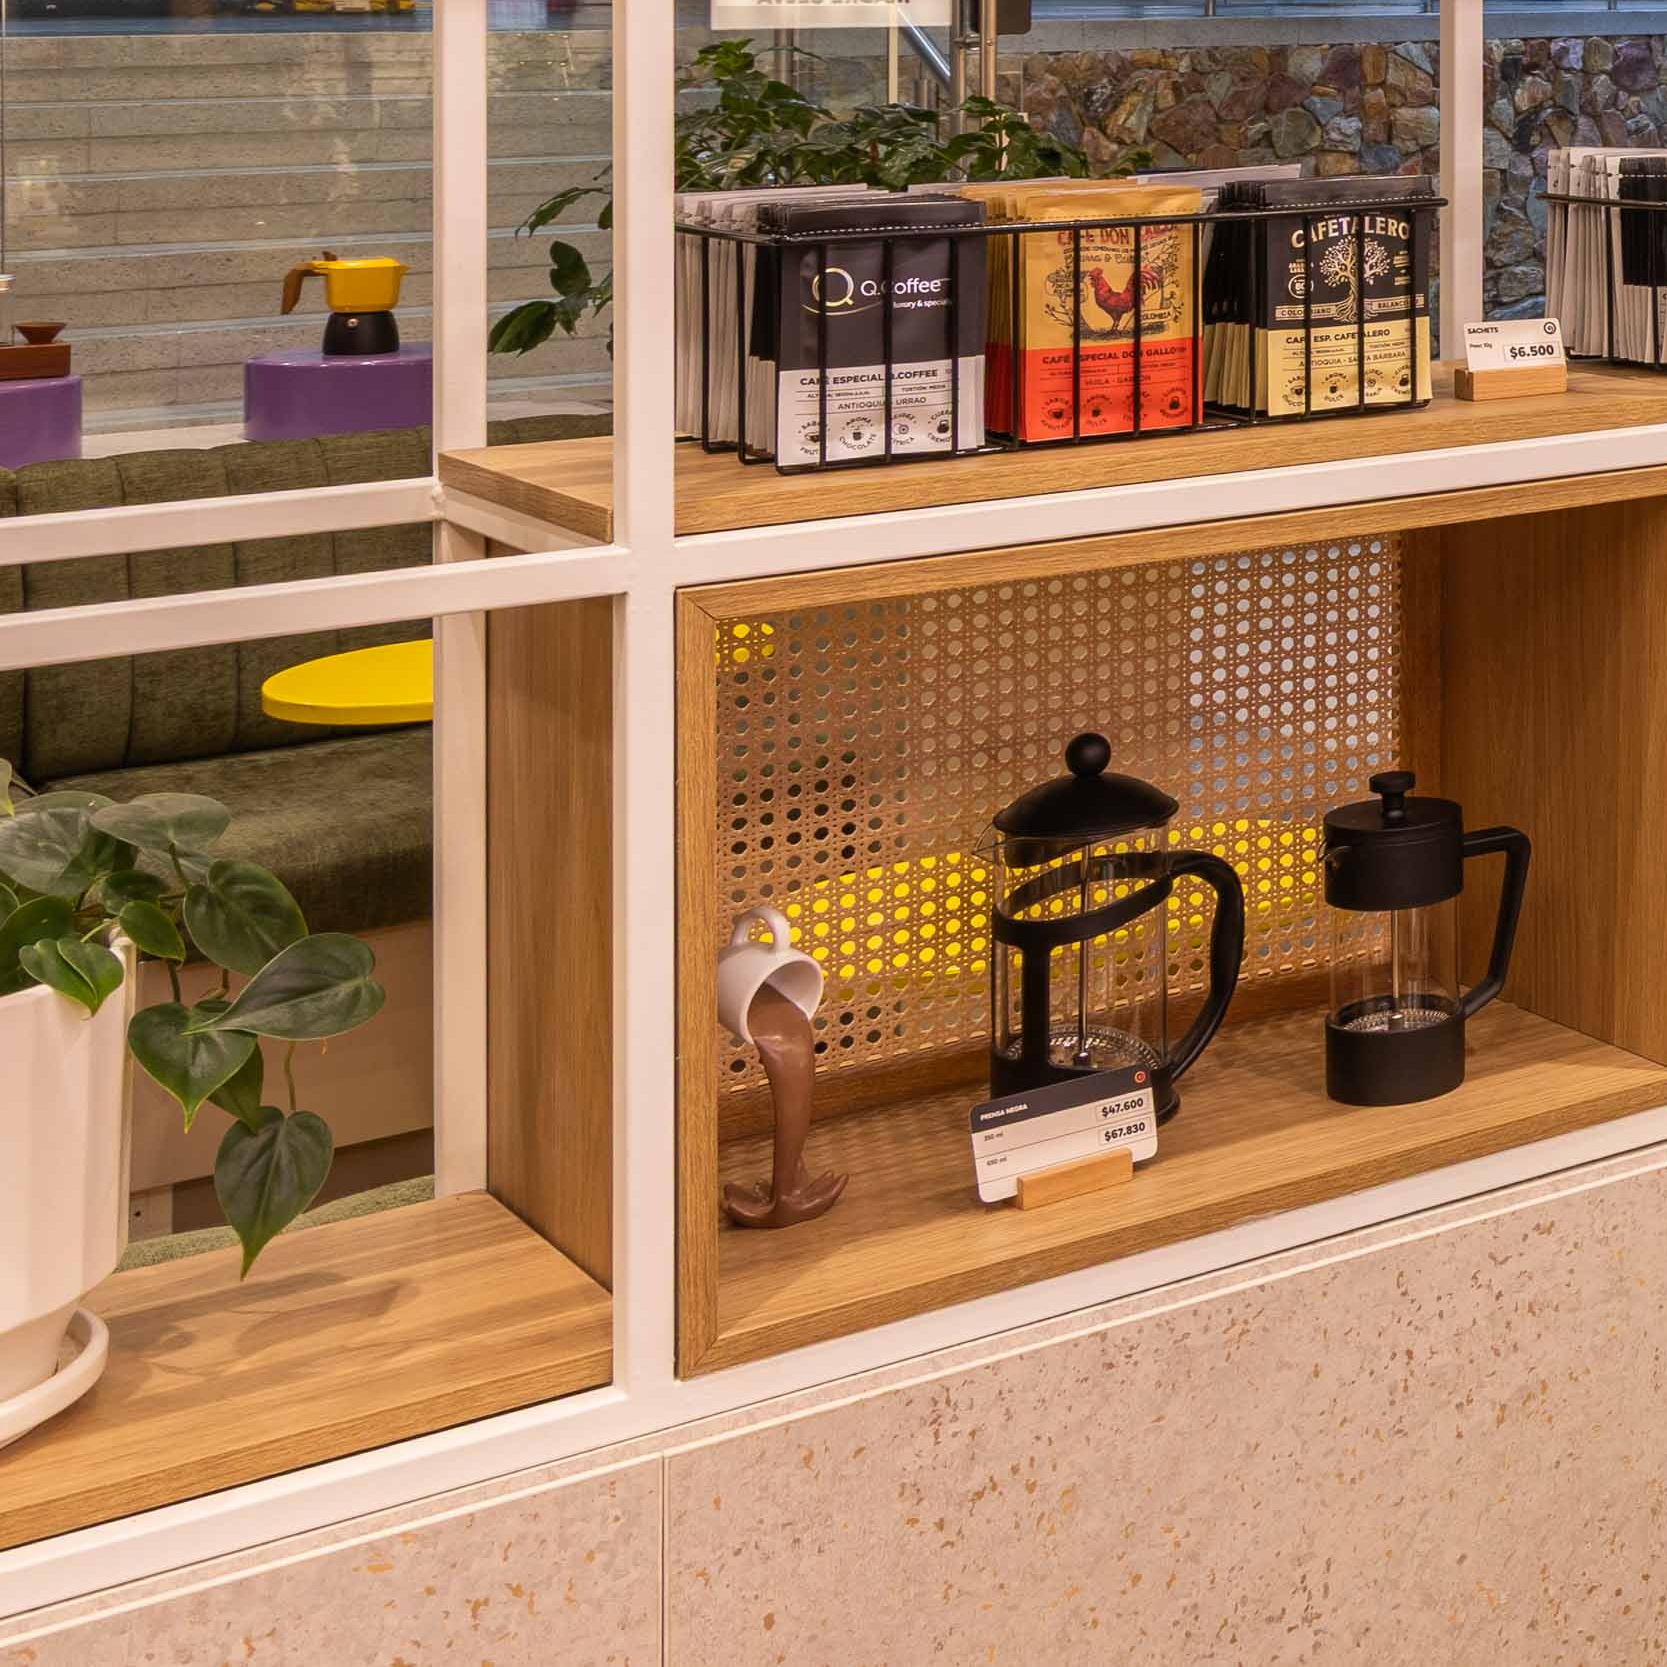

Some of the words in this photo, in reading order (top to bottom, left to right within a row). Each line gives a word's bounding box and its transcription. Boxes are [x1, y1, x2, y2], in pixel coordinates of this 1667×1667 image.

[1510, 345, 1554, 360] $6.500
[1101, 1098, 1144, 1118] $47.600
[1104, 1122, 1145, 1142] $67.830
